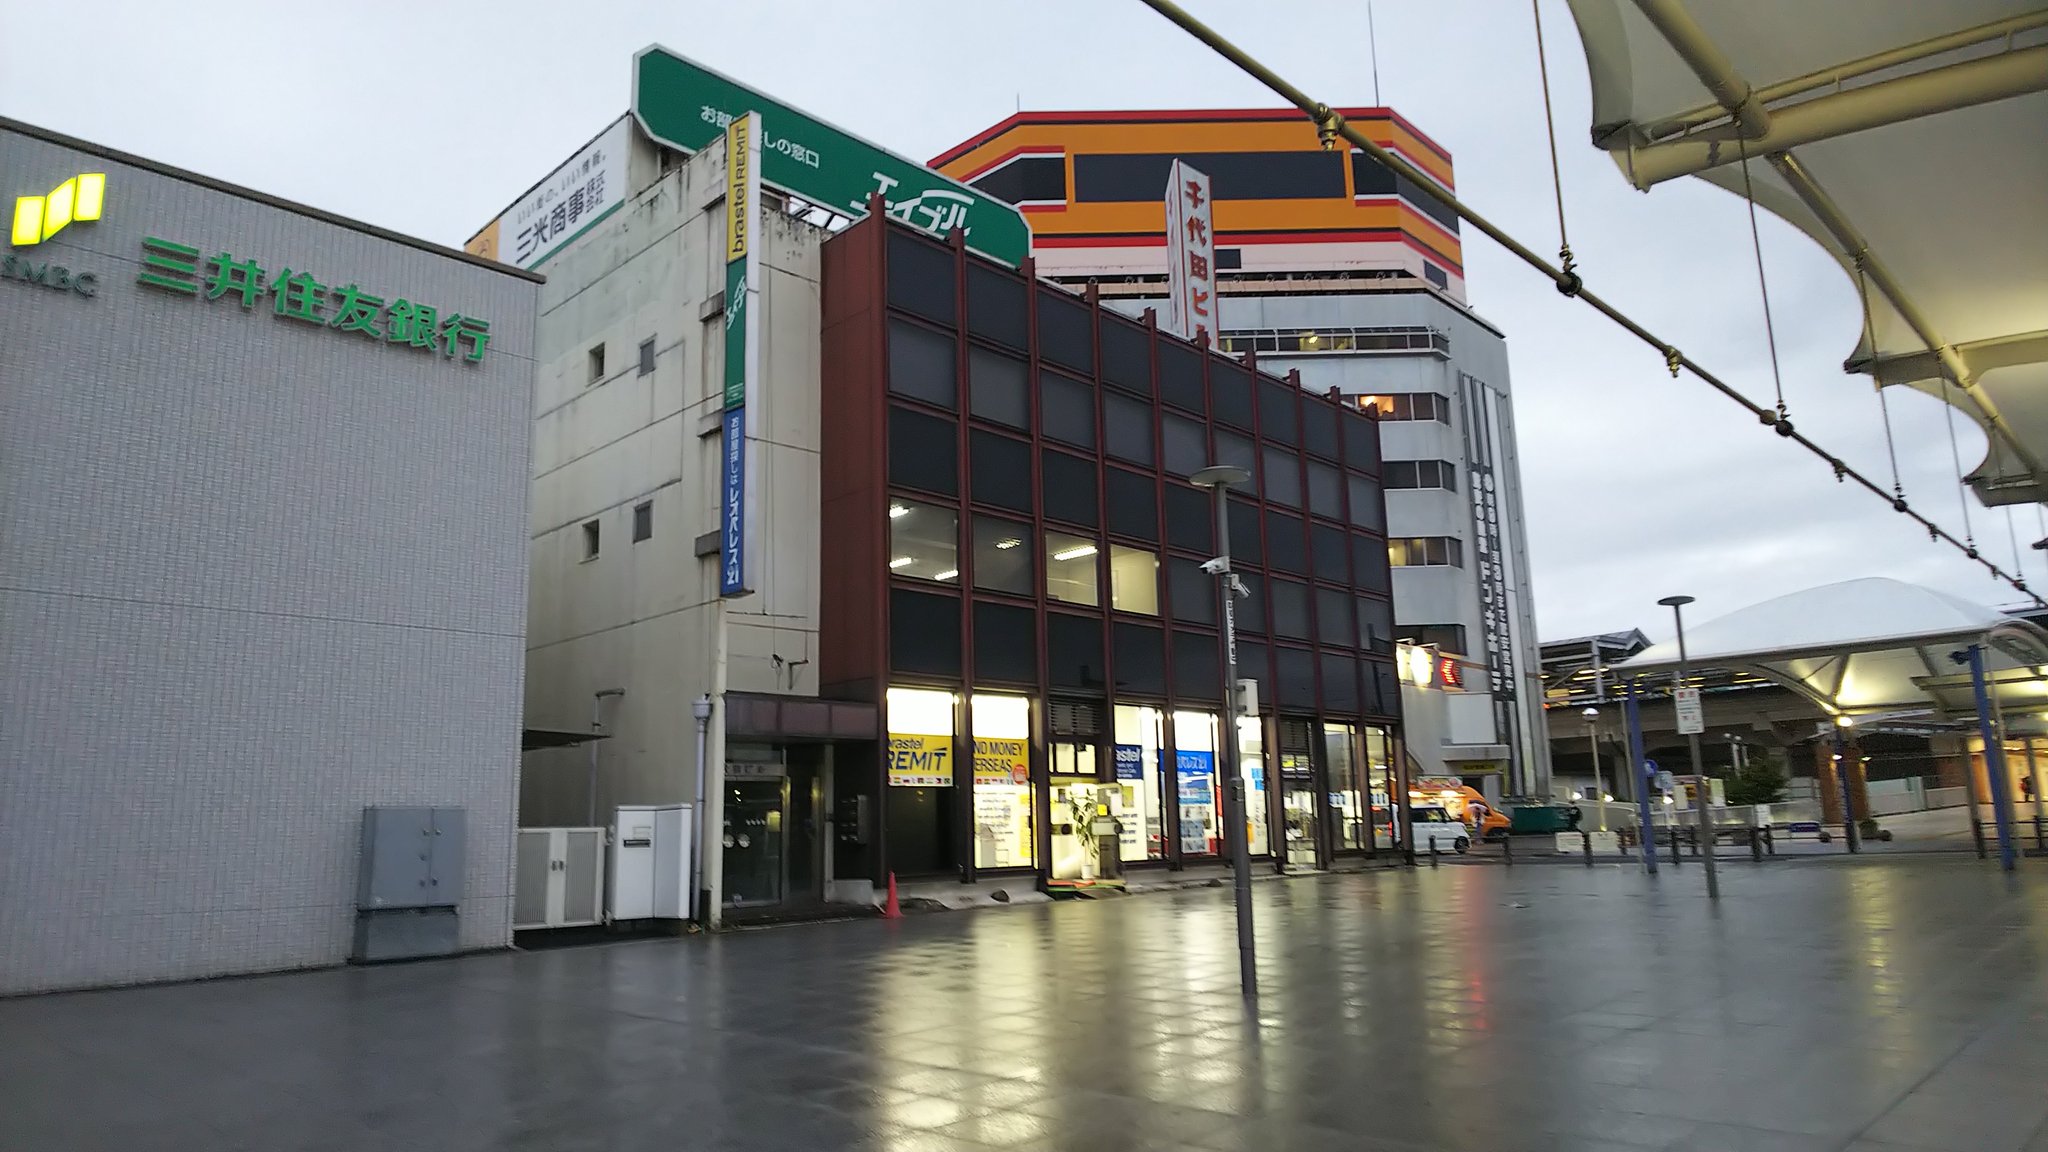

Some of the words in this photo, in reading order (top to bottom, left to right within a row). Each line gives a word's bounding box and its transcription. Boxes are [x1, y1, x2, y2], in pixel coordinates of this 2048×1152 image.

[701, 105, 820, 169] お部しの窓口
[735, 126, 747, 180] REMIT
[732, 182, 745, 253] brastel
[1, 254, 98, 299] SMBC
[136, 236, 491, 363] 三井住友銀行
[990, 741, 1024, 756] MONEY
